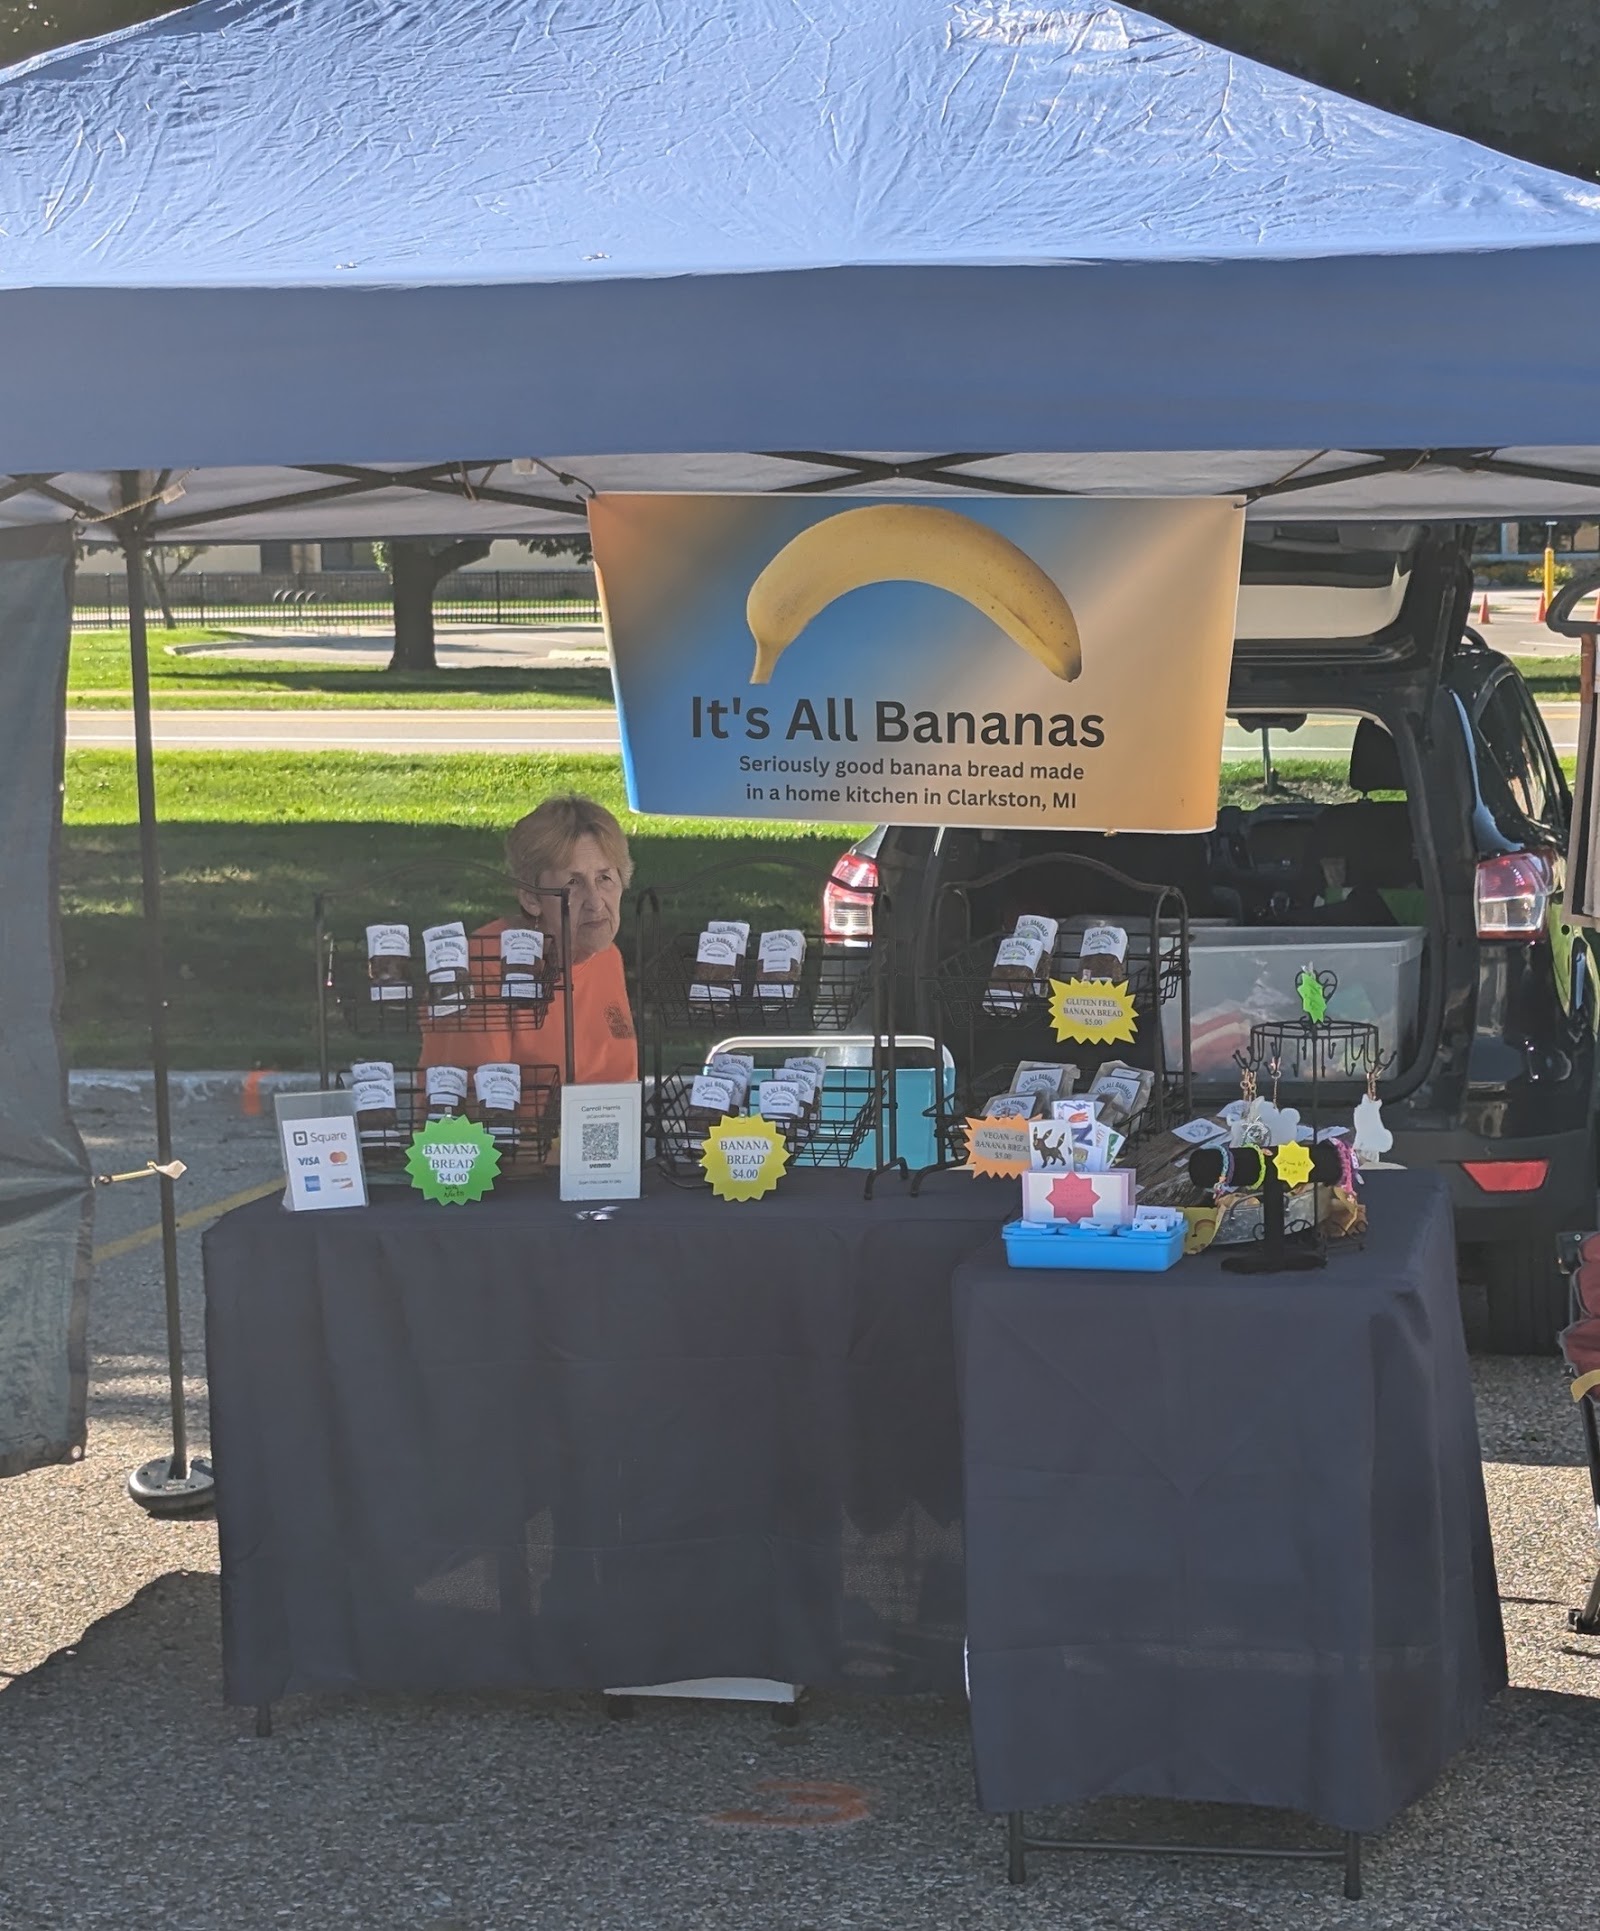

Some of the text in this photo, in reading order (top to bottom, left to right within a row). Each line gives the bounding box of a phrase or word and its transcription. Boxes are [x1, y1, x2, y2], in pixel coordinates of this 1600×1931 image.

[692, 696, 1106, 748] It's All Bananas
[739, 755, 1084, 780] Seriously good banana bread made
[746, 783, 1077, 812] in a home kitchen in Clarkston, MI
[1066, 998, 1117, 1008] GLUTEN FREE
[1063, 1007, 1123, 1018] BANANA BREAD
[1084, 1018, 1103, 1026] $5.00
[310, 1132, 347, 1144] Square
[424, 1145, 478, 1155] BANANA
[720, 1140, 769, 1150] BANANA
[975, 1140, 1007, 1150] BANANA
[298, 1156, 320, 1166] VISA
[432, 1159, 474, 1168] BREAD
[727, 1155, 765, 1165] BREAD
[438, 1173, 468, 1183] $4.00
[732, 1169, 758, 1179] $4.00
